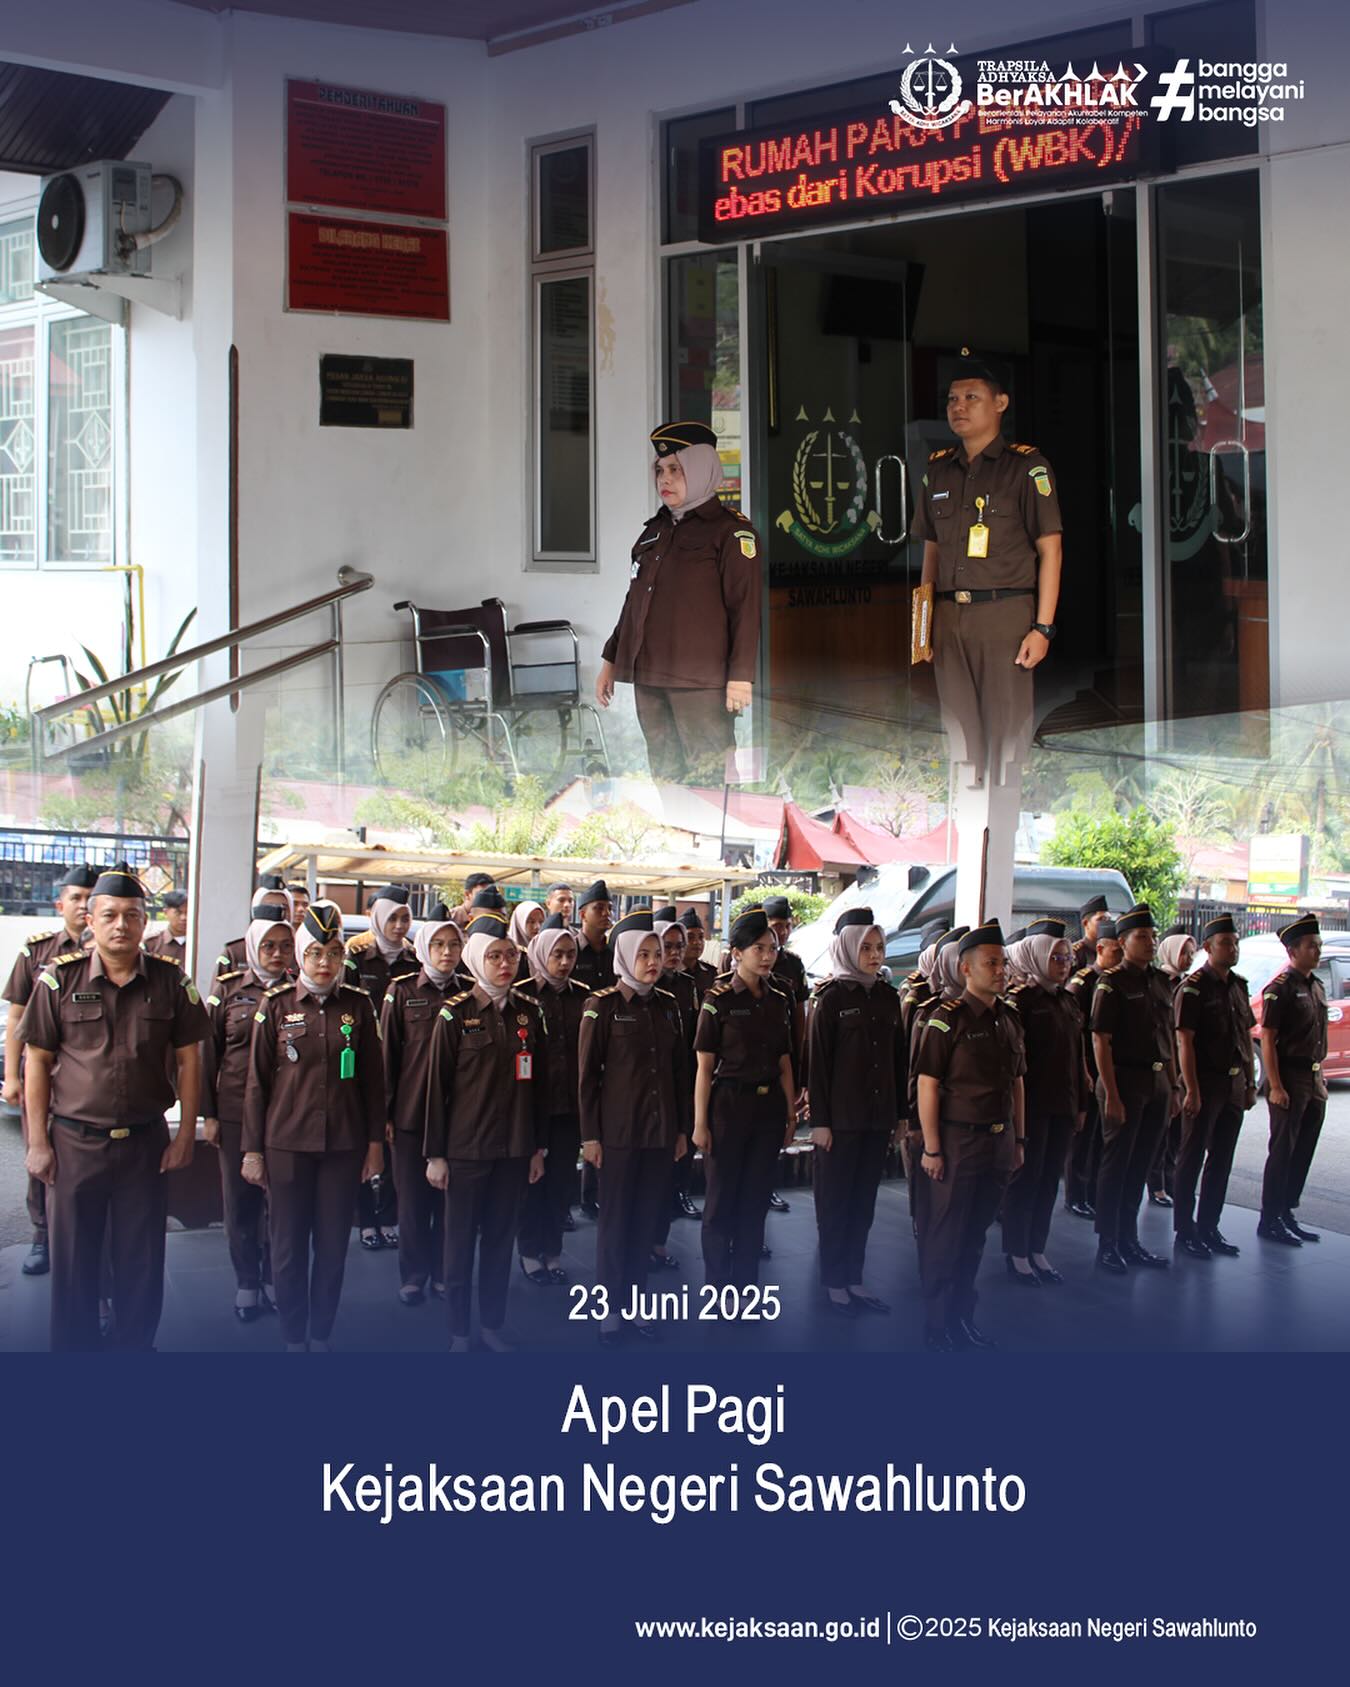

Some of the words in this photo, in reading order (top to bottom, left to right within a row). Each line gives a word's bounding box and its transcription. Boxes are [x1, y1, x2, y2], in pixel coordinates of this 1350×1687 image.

[721, 127, 839, 182] RUMAH
[714, 187, 783, 222] ebas
[786, 170, 849, 210] dari
[855, 145, 983, 200] Korupsi
[788, 586, 872, 608] SAWAHLUNTO
